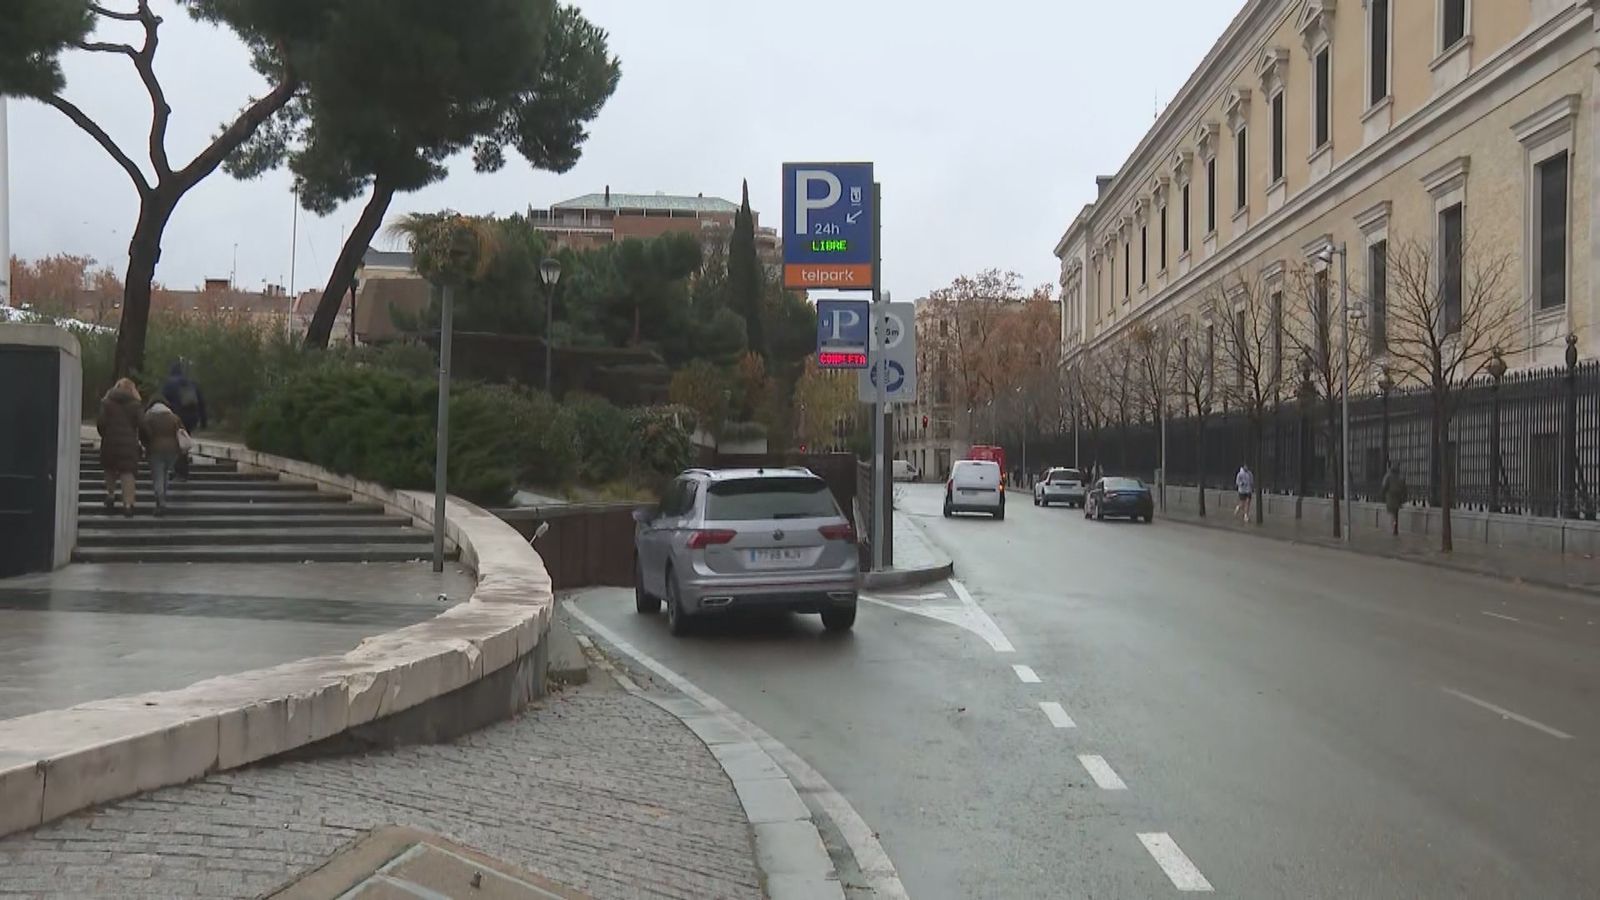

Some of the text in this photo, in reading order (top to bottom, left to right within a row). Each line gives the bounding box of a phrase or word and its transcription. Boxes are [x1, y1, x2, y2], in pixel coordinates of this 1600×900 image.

[795, 170, 842, 235] P
[815, 222, 840, 235] 24h
[812, 240, 847, 251] LIBRE
[801, 268, 854, 284] telpark
[829, 309, 860, 339] P
